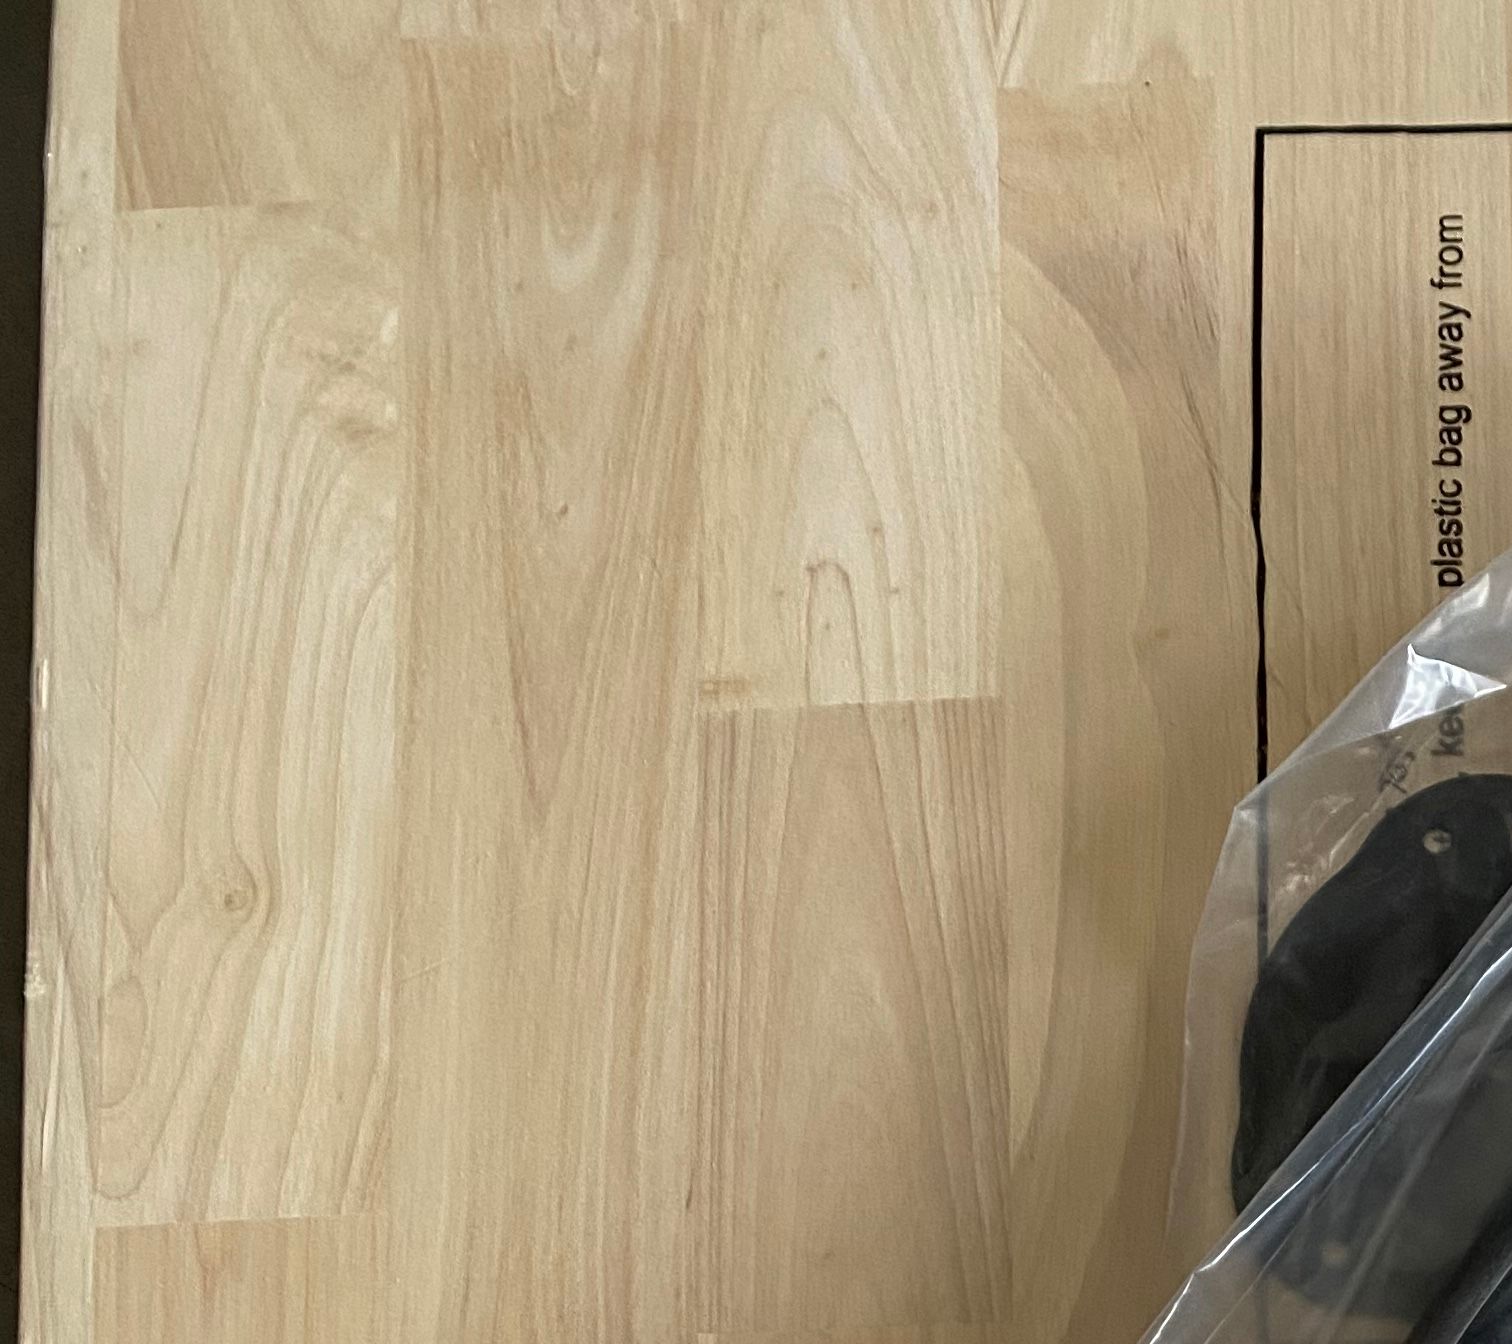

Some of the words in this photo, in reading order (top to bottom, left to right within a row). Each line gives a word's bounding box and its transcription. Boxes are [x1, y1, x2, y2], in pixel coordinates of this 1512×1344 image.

[1430, 212, 1464, 290] from
[1436, 300, 1472, 392] away
[1431, 403, 1472, 467] bag
[1429, 477, 1465, 587] plastic
